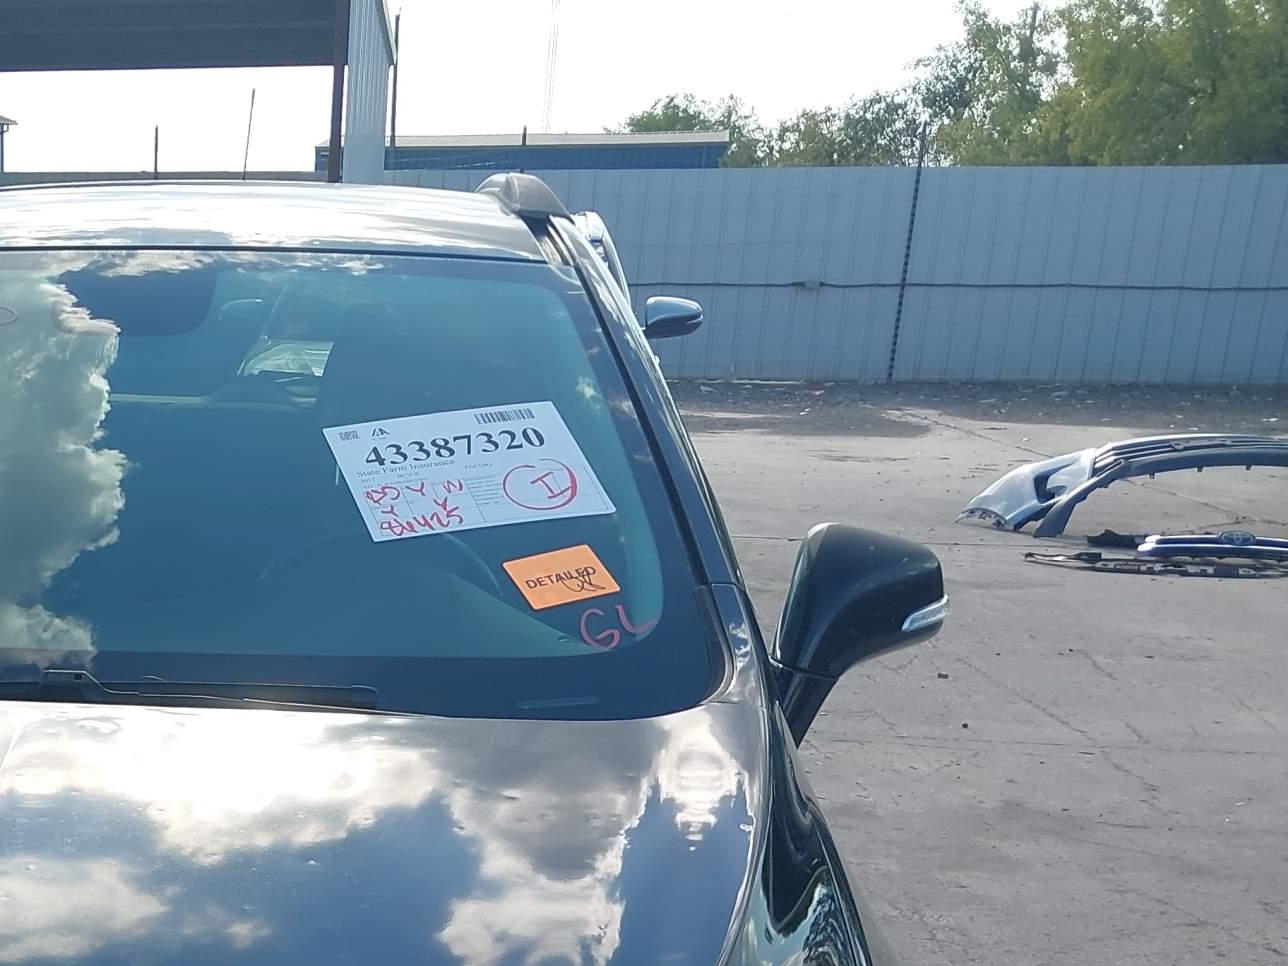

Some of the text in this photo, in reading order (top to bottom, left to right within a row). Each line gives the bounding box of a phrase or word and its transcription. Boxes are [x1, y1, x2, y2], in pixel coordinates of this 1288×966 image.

[365, 427, 545, 466] 43387320
[357, 459, 455, 478] State Farm Insurance
[525, 566, 597, 590] DETAILED
